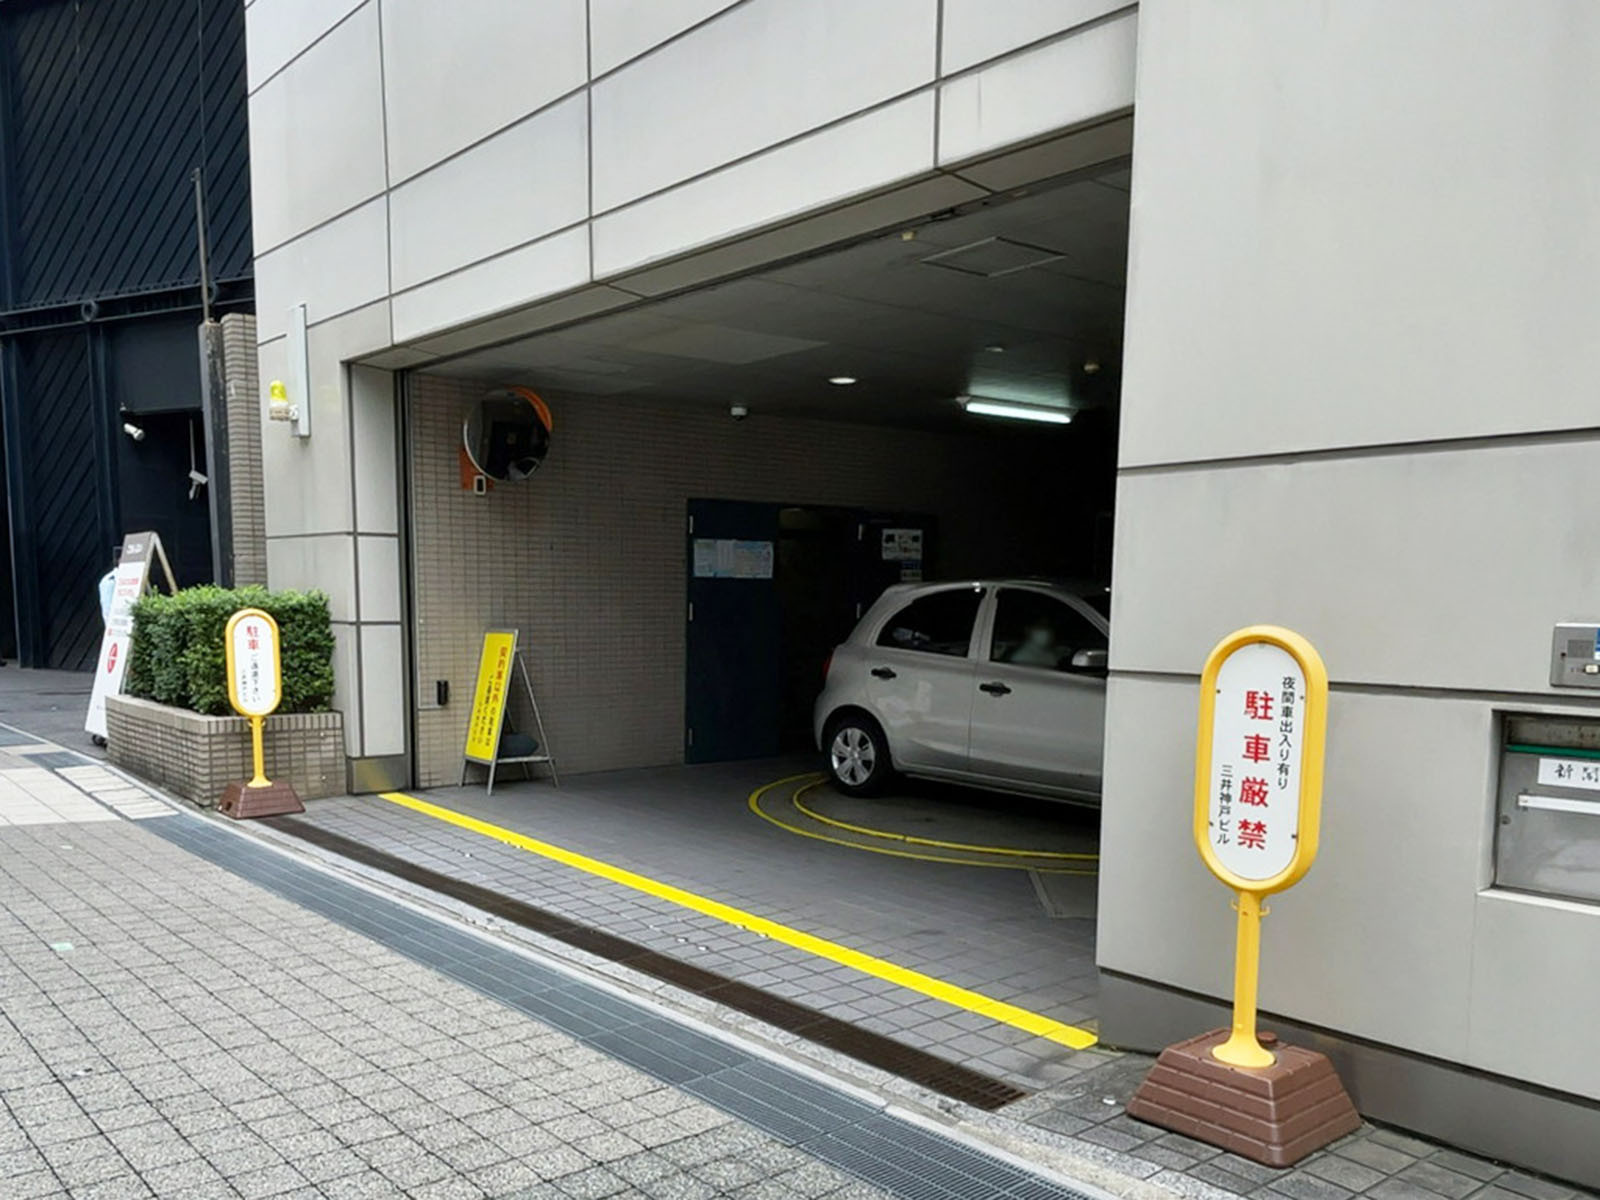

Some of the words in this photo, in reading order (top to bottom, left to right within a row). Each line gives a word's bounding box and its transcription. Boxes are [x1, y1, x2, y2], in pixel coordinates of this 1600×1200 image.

[1237, 690, 1275, 850] 駐車厳禁
[1277, 676, 1296, 790] 夜間車出入り有り
[1217, 764, 1233, 845] 三井神戸ビル
